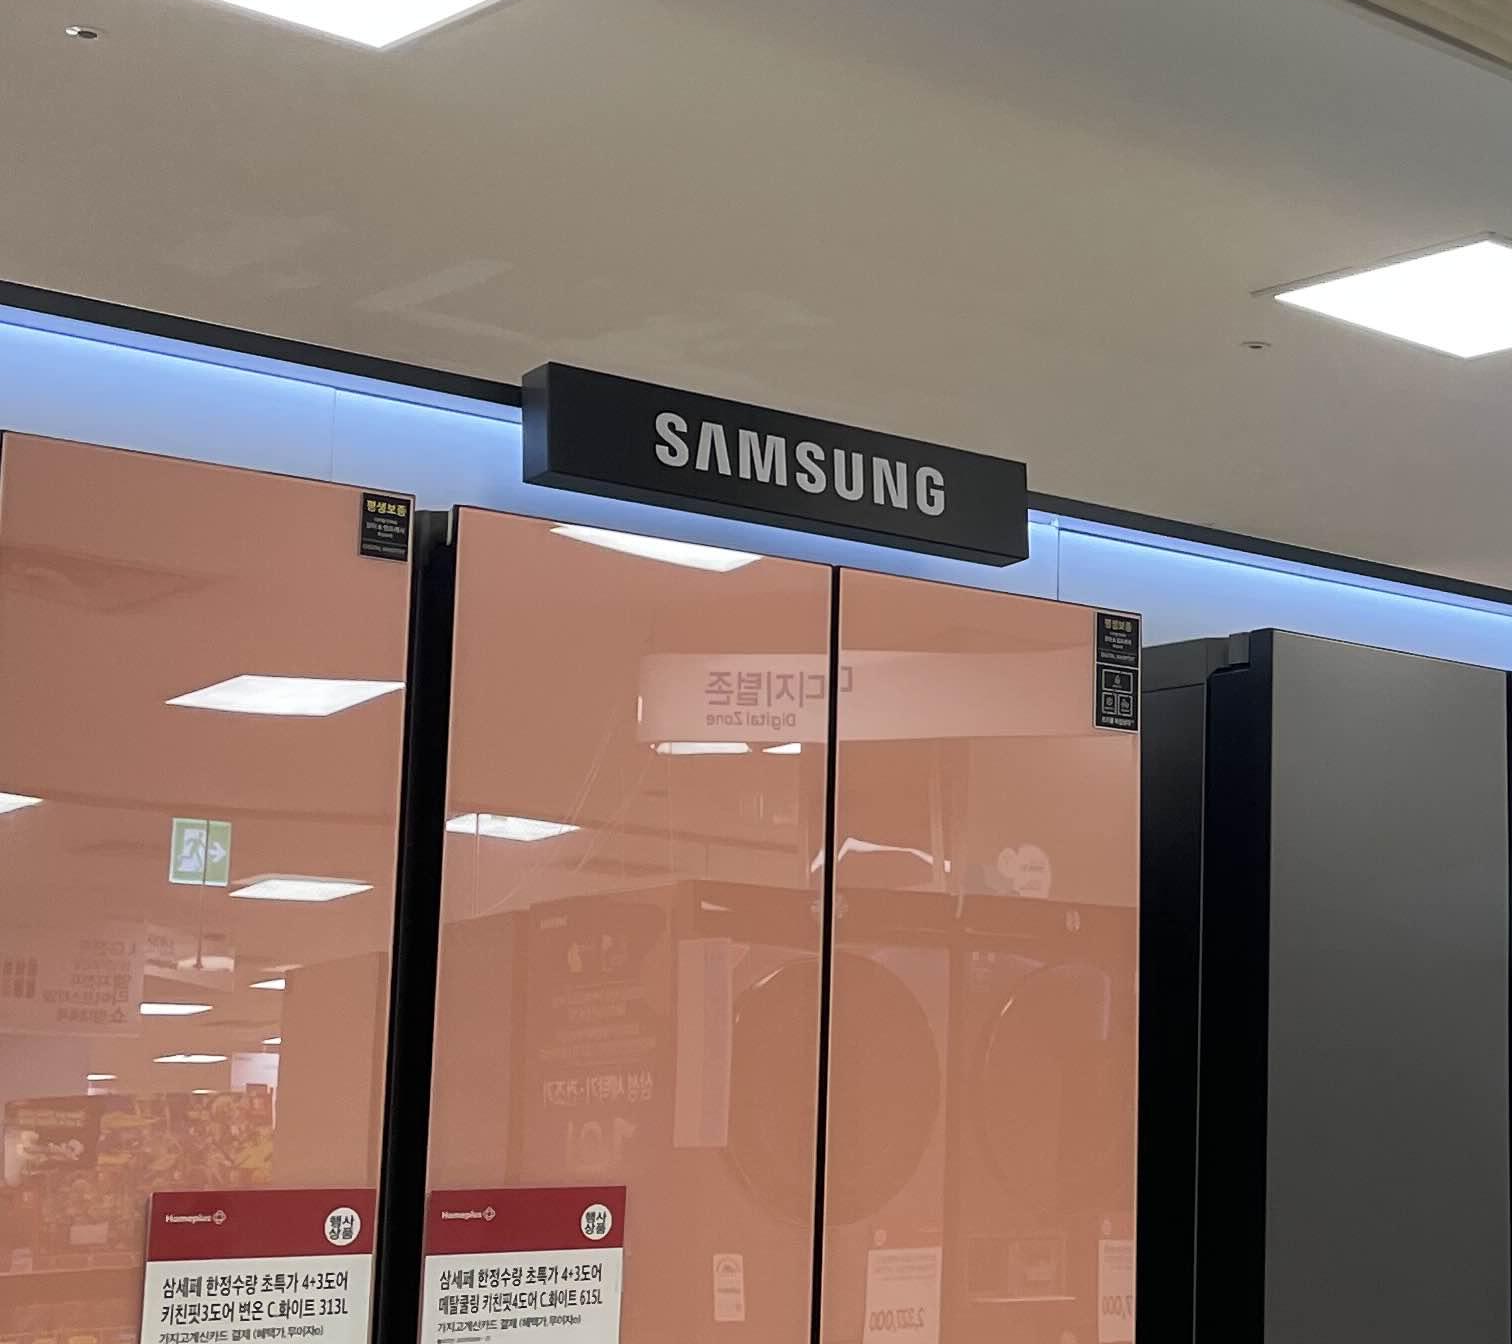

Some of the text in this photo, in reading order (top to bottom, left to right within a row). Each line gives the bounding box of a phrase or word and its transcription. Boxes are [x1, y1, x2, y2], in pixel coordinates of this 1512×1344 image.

[655, 412, 945, 516] SAMSUNG
[162, 1270, 349, 1299] 삼세페 한정수량 초특가 4+3도어
[439, 1263, 603, 1291] 삼세페 한정수량 초특가 4+3도어
[160, 1301, 235, 1325] 키친핏3도어
[239, 1300, 264, 1322] 변온
[319, 1297, 349, 1316] 313L
[438, 1293, 479, 1316] 메탈쿨링
[482, 1290, 538, 1314] 키친핏4도어
[580, 1288, 603, 1306] 615L
[159, 1329, 229, 1344] 가지고계신카드
